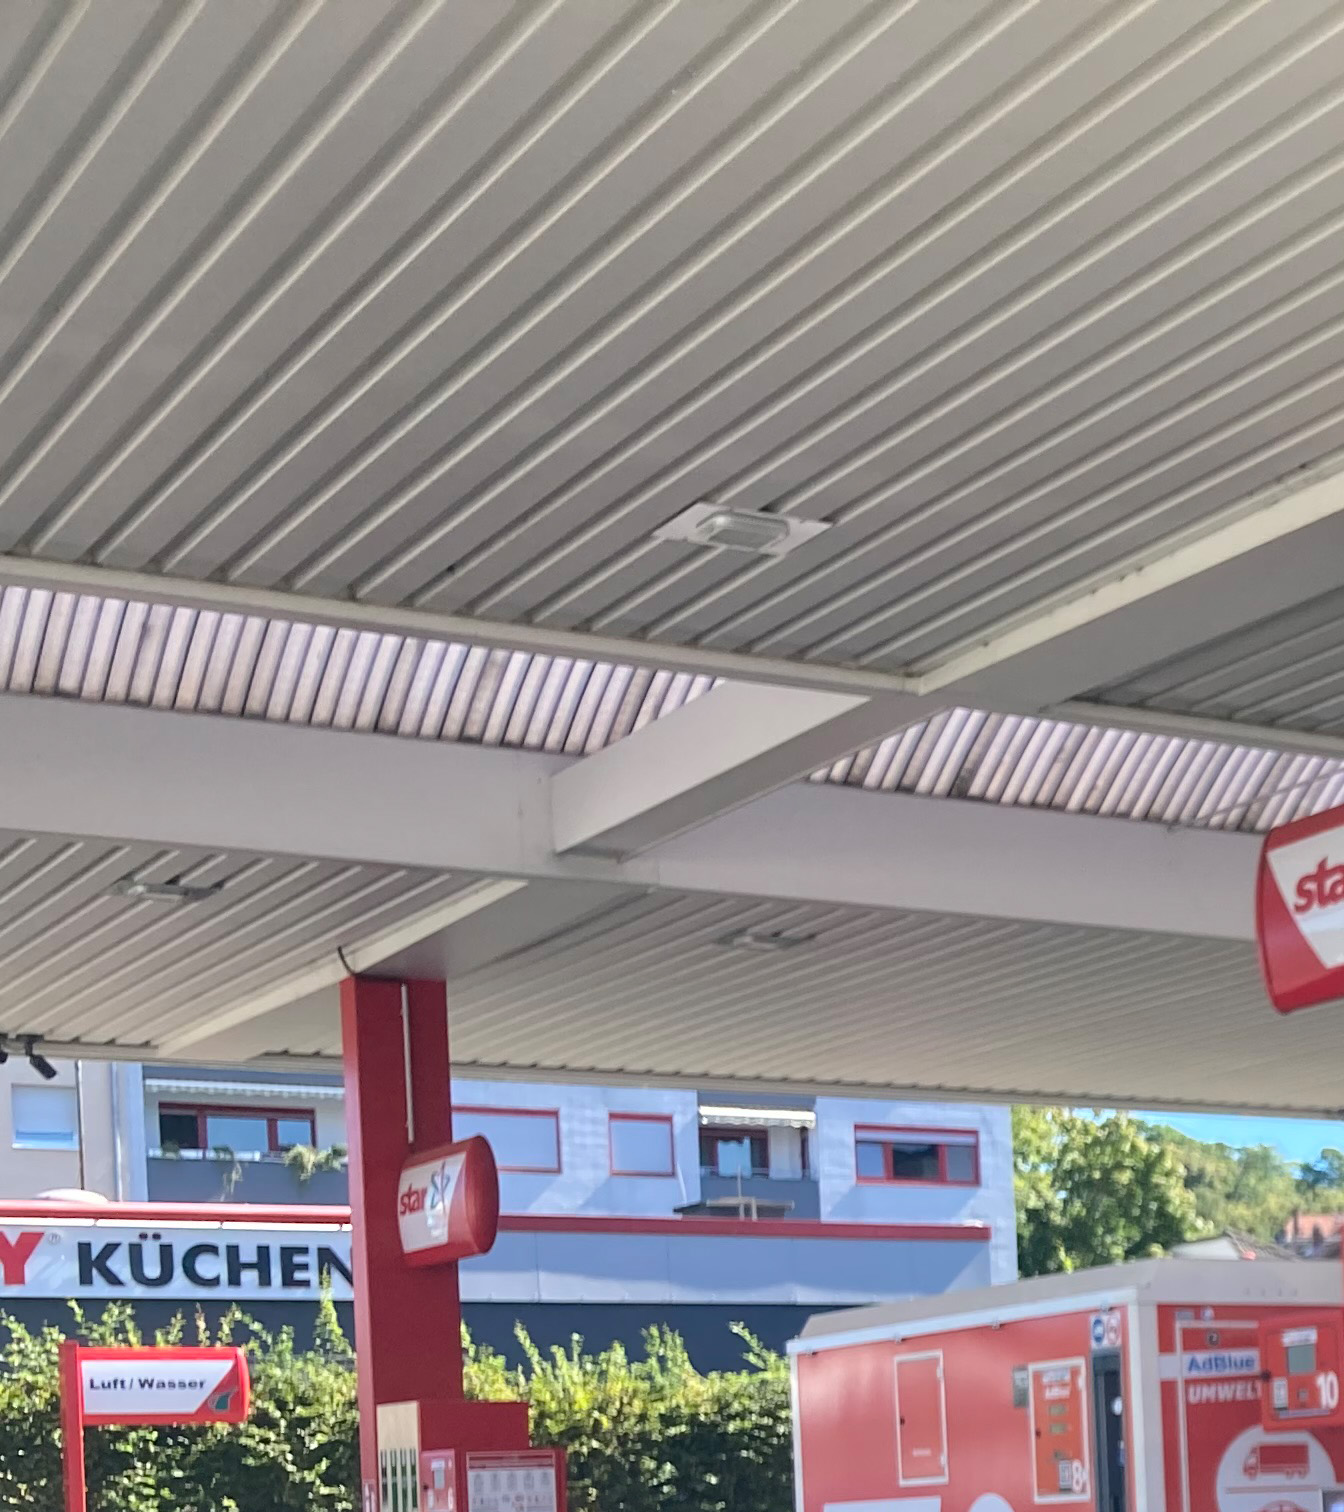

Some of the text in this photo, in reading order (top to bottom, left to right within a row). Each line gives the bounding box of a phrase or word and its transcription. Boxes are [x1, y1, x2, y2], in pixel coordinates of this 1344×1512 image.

[399, 1183, 427, 1215] star
[77, 1233, 354, 1289] KÜCHEN
[1188, 1353, 1256, 1373] AdBlue
[90, 1377, 126, 1390] Luft
[138, 1377, 207, 1391] Wasser
[1316, 1370, 1339, 1409] 10
